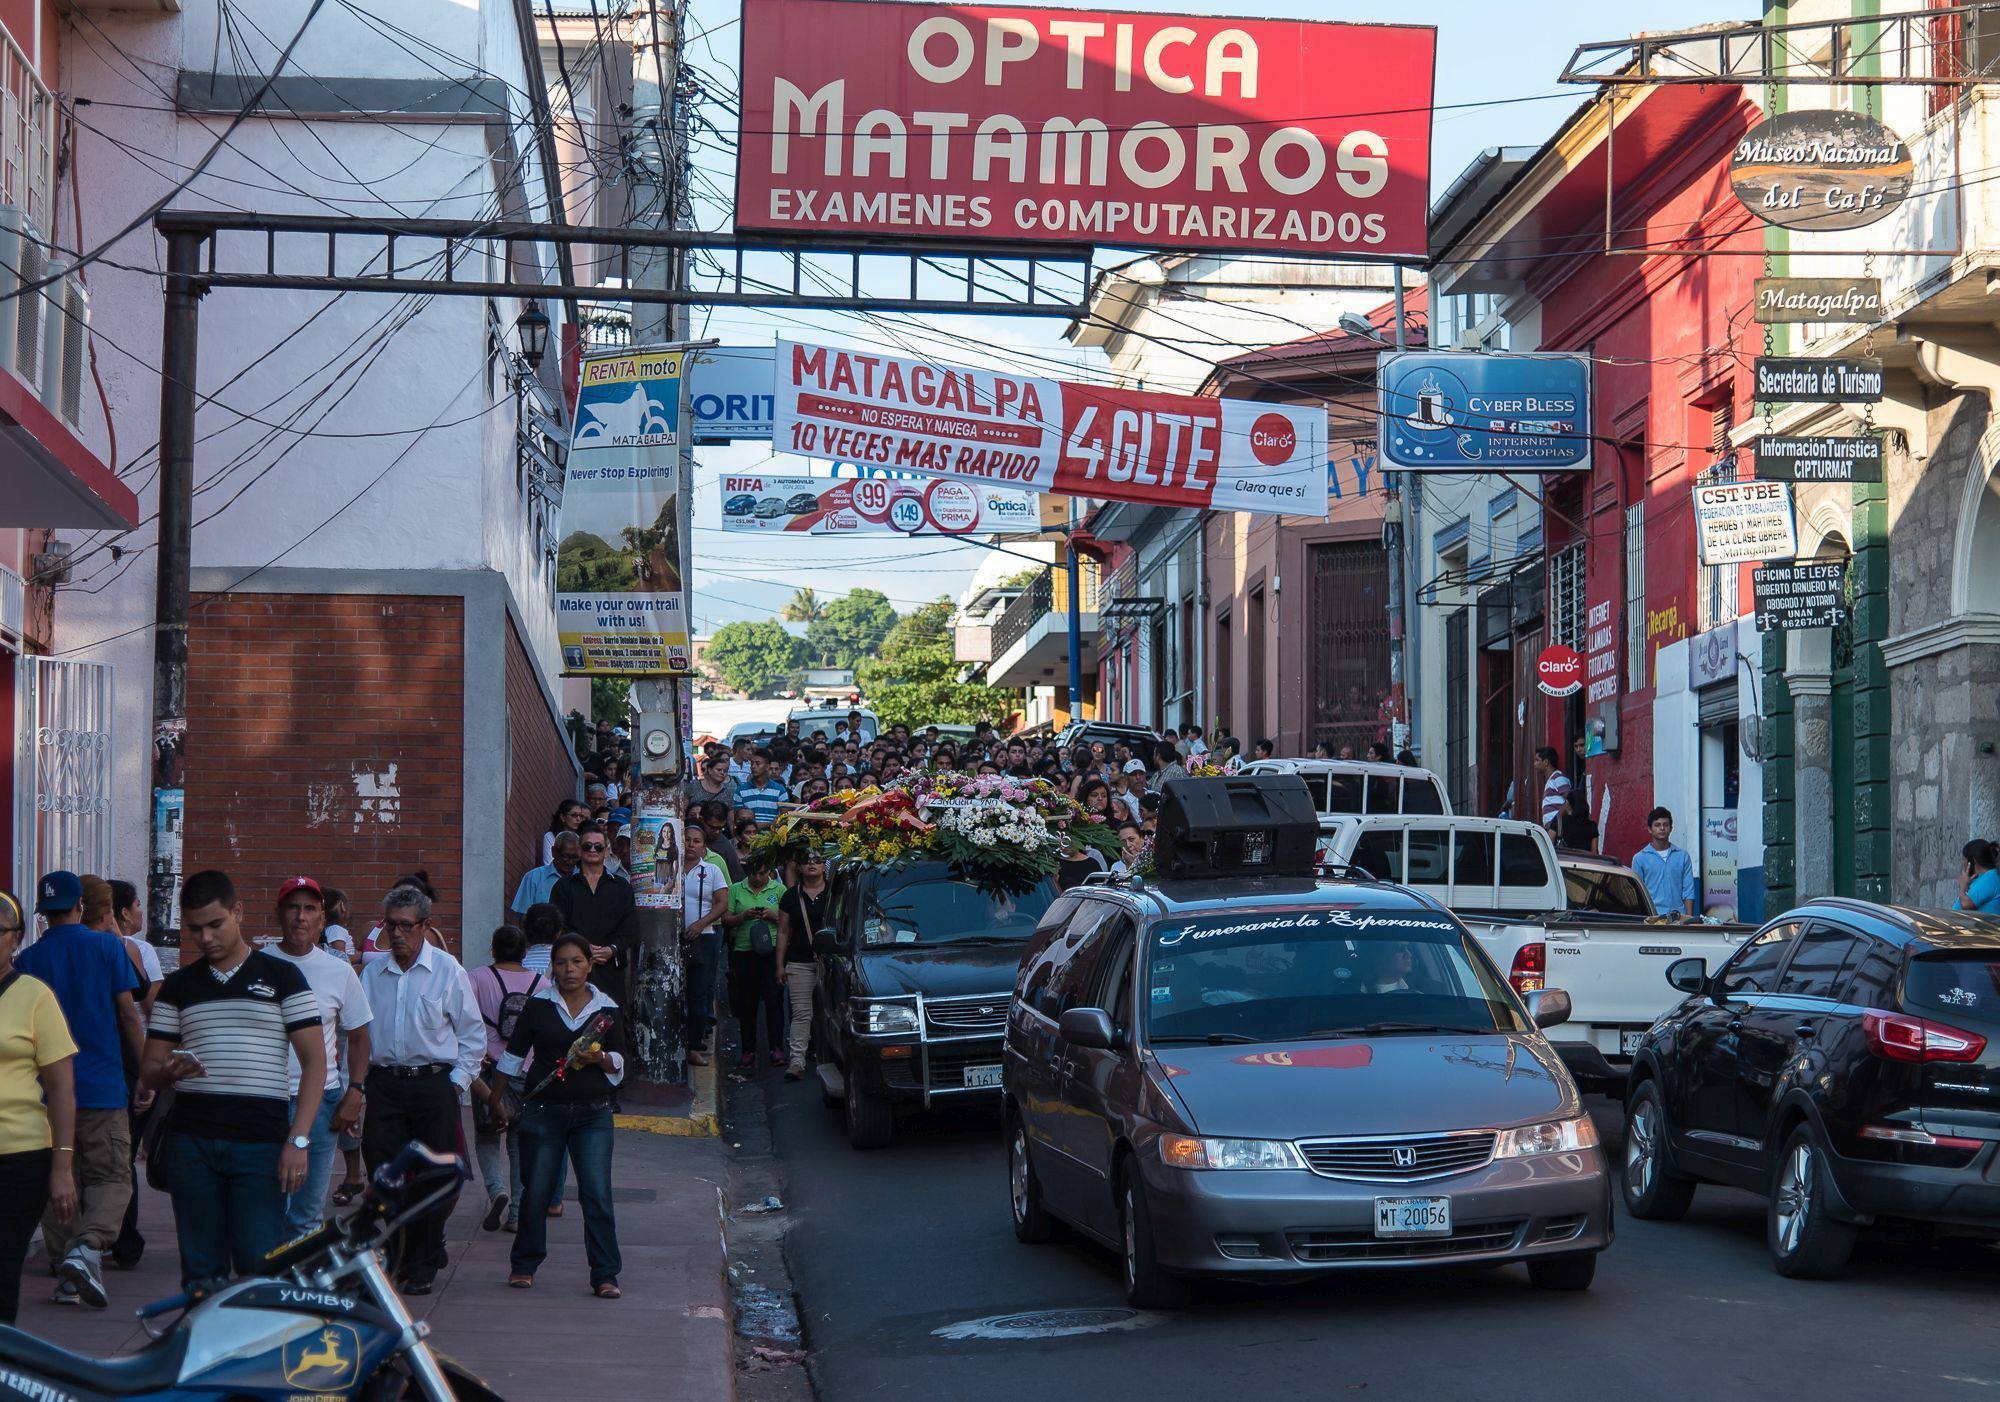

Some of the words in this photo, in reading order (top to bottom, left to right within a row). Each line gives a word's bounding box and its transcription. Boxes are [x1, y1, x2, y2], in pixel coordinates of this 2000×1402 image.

[907, 16, 1259, 98] OPTICA
[771, 76, 1388, 199] MATAMOROS
[1734, 141, 1806, 163] Museo
[1805, 141, 1901, 164] Nacional
[1763, 183, 1804, 209] del
[1824, 185, 1888, 213] Café
[770, 188, 992, 228] EXAMENES
[1014, 198, 1385, 244] COMPUTARIZADOS
[1760, 287, 1879, 316] Matagalpa
[589, 361, 636, 381] RENTA
[640, 358, 677, 376] moto
[793, 345, 1043, 422] MATAGALPA
[1760, 366, 1818, 394] Secretaría
[1822, 366, 1836, 394] de
[1838, 366, 1881, 394] Turismo
[861, 409, 878, 422] NO
[881, 412, 924, 430] ESPERA
[926, 419, 934, 431] Y
[935, 420, 978, 438] NAVEGA
[612, 434, 673, 445] MATAGALPA
[1254, 432, 1290, 448] Claro
[1489, 438, 1556, 446] INTERNET
[1760, 438, 1827, 458] Información
[1826, 439, 1878, 458] Turística
[790, 422, 817, 450] 10
[823, 426, 889, 463] VECES
[895, 439, 948, 471] MAS
[955, 446, 1041, 482] RAPIDO
[1489, 448, 1574, 457] FOTOCOPIAS
[570, 468, 598, 480] Never
[600, 467, 625, 479] Stop
[628, 465, 673, 479] Exploring!
[1794, 460, 1853, 479] CIPTURMAT
[726, 478, 763, 491] RIFA
[938, 487, 963, 496] PAGA
[1235, 480, 1267, 495] Claro
[1269, 484, 1293, 498] que
[1295, 484, 1307, 498] sí
[856, 483, 886, 509] $99
[894, 504, 918, 522] $149
[988, 500, 1027, 515] Optica
[1700, 506, 1735, 519] FEDERACION
[1736, 504, 1744, 516] DE
[1744, 500, 1788, 515] TRABAJADORES
[941, 514, 970, 522] PRIMA
[1708, 521, 1738, 533] HEROES
[1740, 520, 1744, 529] Y
[1747, 515, 1782, 529] MARTIRES
[1707, 536, 1718, 547] DE
[1720, 535, 1730, 546] LA
[1732, 532, 1756, 545] CLASE
[1758, 529, 1787, 542] OBRERA
[1755, 568, 1791, 581] OFICINA
[1793, 567, 1807, 580] DE
[1809, 566, 1840, 578] LEYES
[1756, 583, 1790, 596] ROBERTO
[1828, 580, 1840, 591] M.
[560, 599, 591, 611] Make
[595, 600, 624, 613] your
[626, 601, 654, 611] own
[655, 598, 679, 611] trail
[1766, 596, 1800, 610] ABOGADO
[1799, 596, 1804, 609] Y
[1805, 594, 1836, 607] NOTARIO
[597, 615, 626, 627] with
[629, 615, 646, 627] us!
[1588, 600, 1610, 628] INTERNET
[1787, 609, 1813, 618] UNAN
[669, 646, 683, 656] You
[1540, 660, 1574, 672] Claro
[1588, 649, 1615, 678] FOTOCOPIAS
[1540, 684, 1566, 696] RECARGA
[1711, 850, 1729, 859] Reloj
[1709, 887, 1731, 895] Aretes
[1160, 917, 1298, 945] Funeraria
[1296, 914, 1321, 927] la
[1328, 910, 1454, 931] Esperanza
[1381, 1209, 1397, 1226] MT
[1404, 1207, 1446, 1226] 20056
